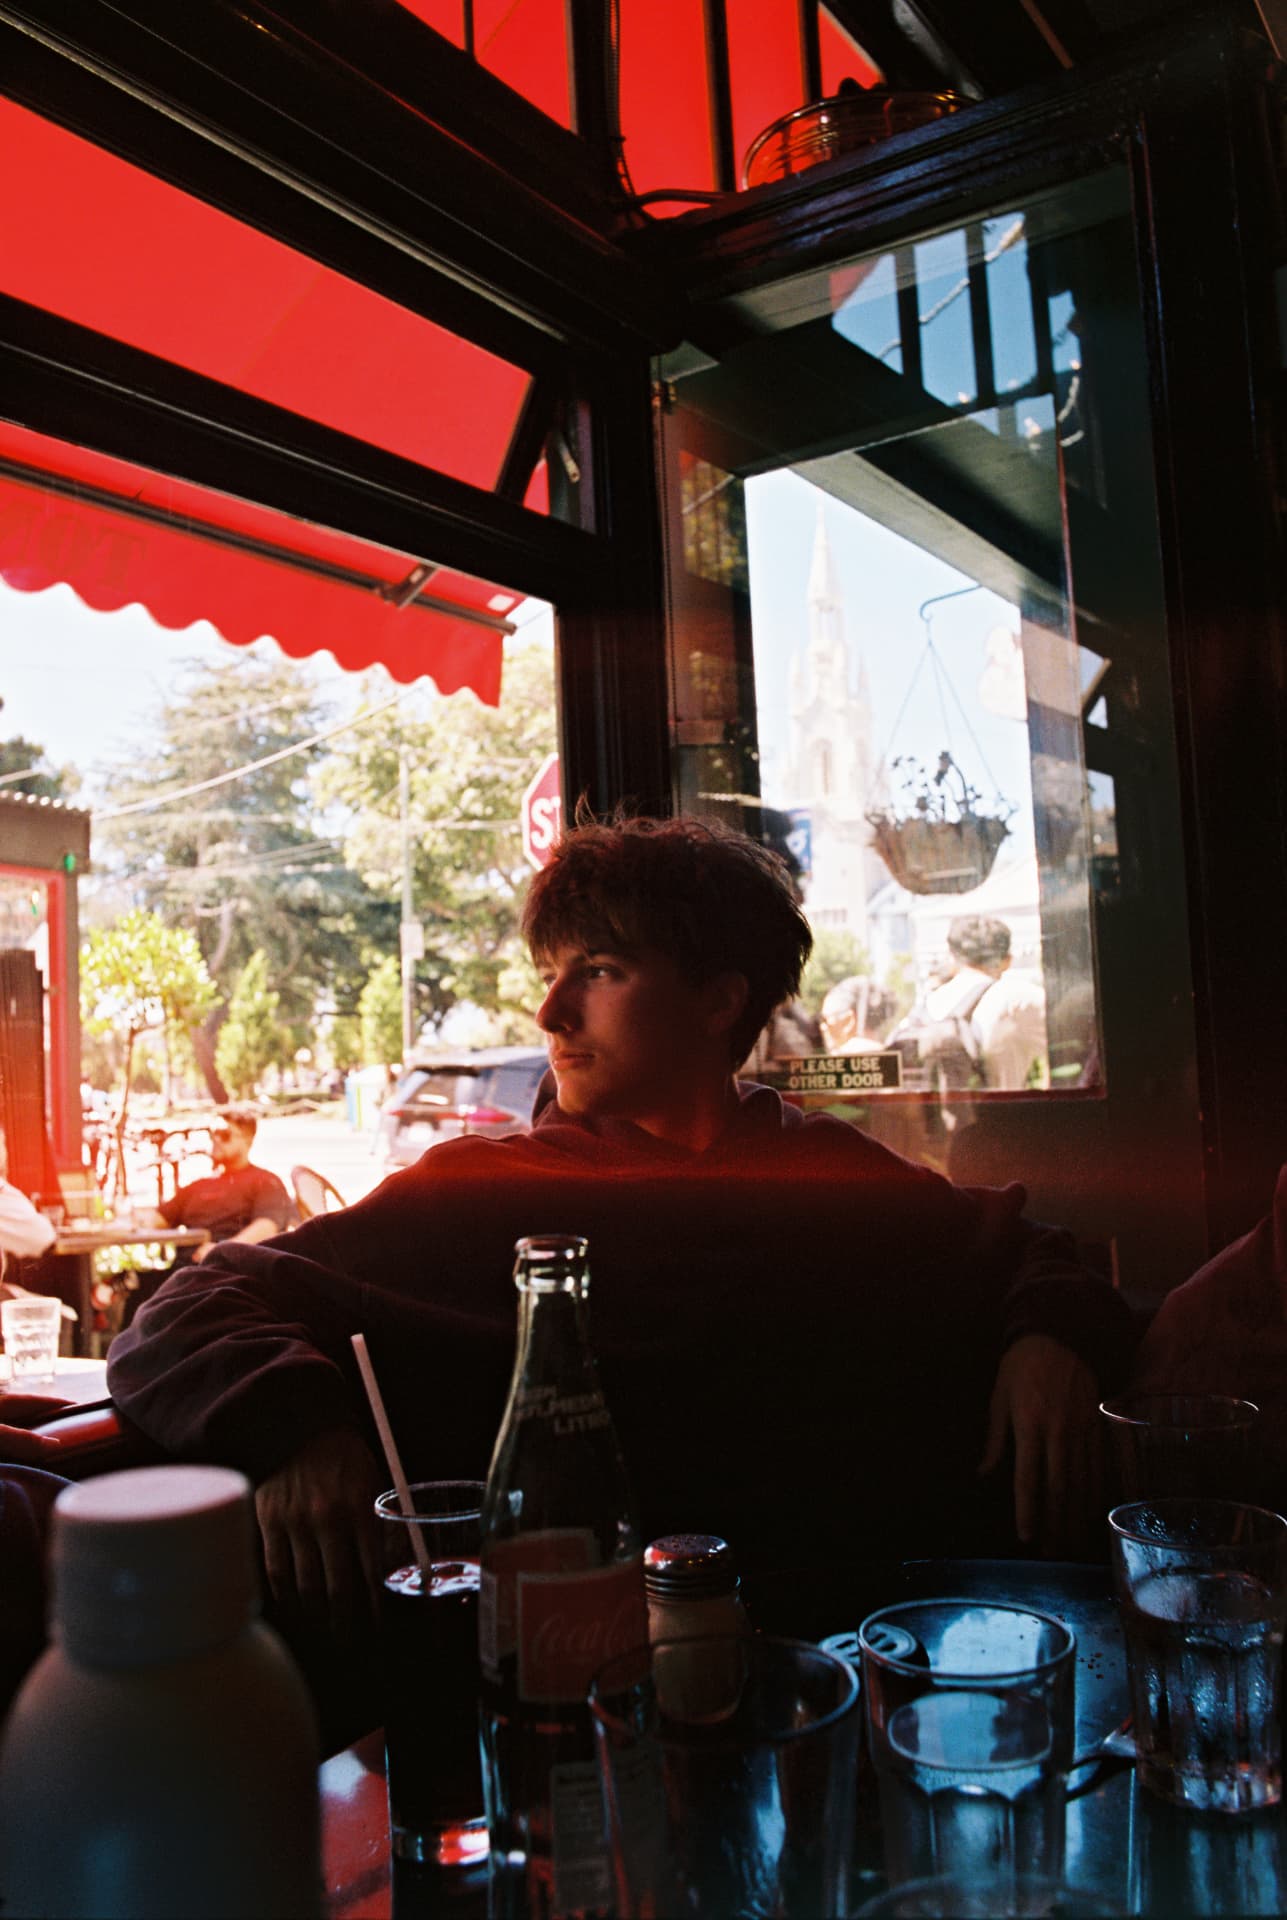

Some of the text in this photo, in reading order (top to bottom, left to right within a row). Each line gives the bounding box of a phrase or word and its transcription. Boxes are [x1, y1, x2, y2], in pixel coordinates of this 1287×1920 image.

[790, 1056, 881, 1073] PLEASE USE
[789, 1073, 884, 1089] OTHER DOOR
